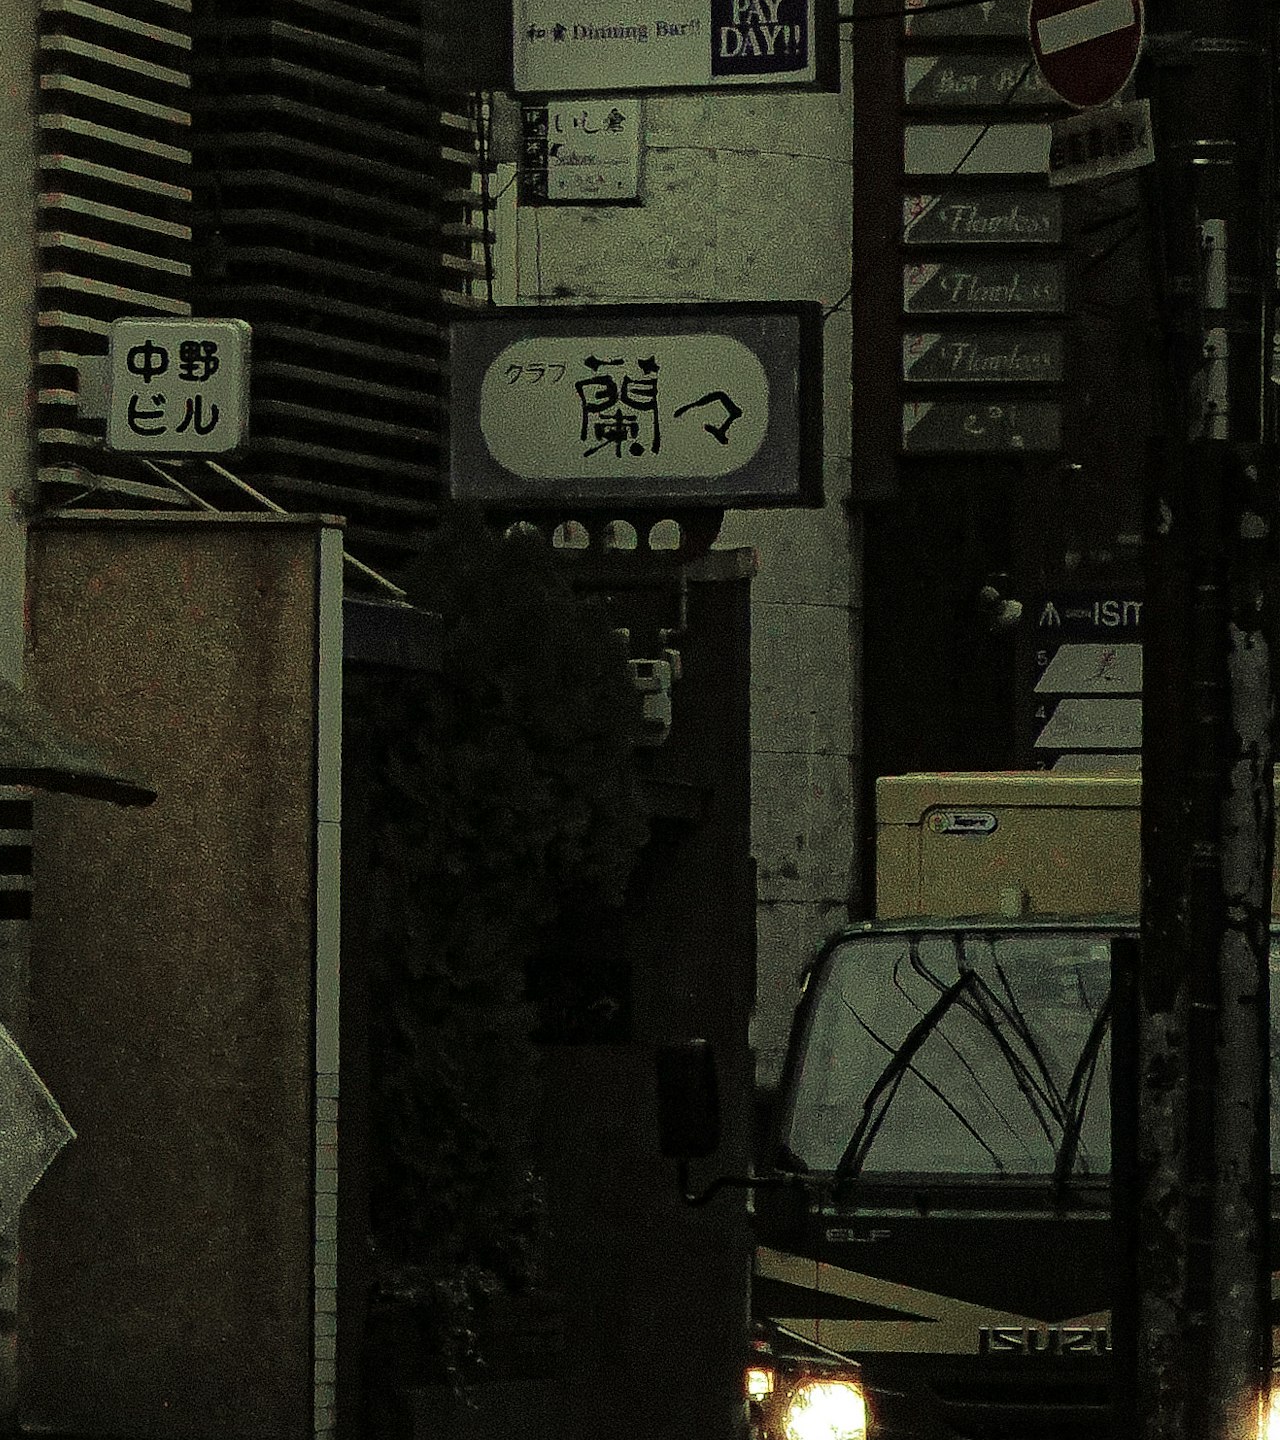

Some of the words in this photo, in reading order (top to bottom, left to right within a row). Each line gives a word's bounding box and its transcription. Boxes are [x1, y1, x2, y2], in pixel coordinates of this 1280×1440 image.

[719, 23, 802, 59] DAY!!
[127, 339, 219, 383] 中野
[127, 394, 219, 435] ビル
[1036, 650, 1048, 666] 5
[1035, 705, 1046, 719] 4
[825, 1228, 892, 1243] ELF
